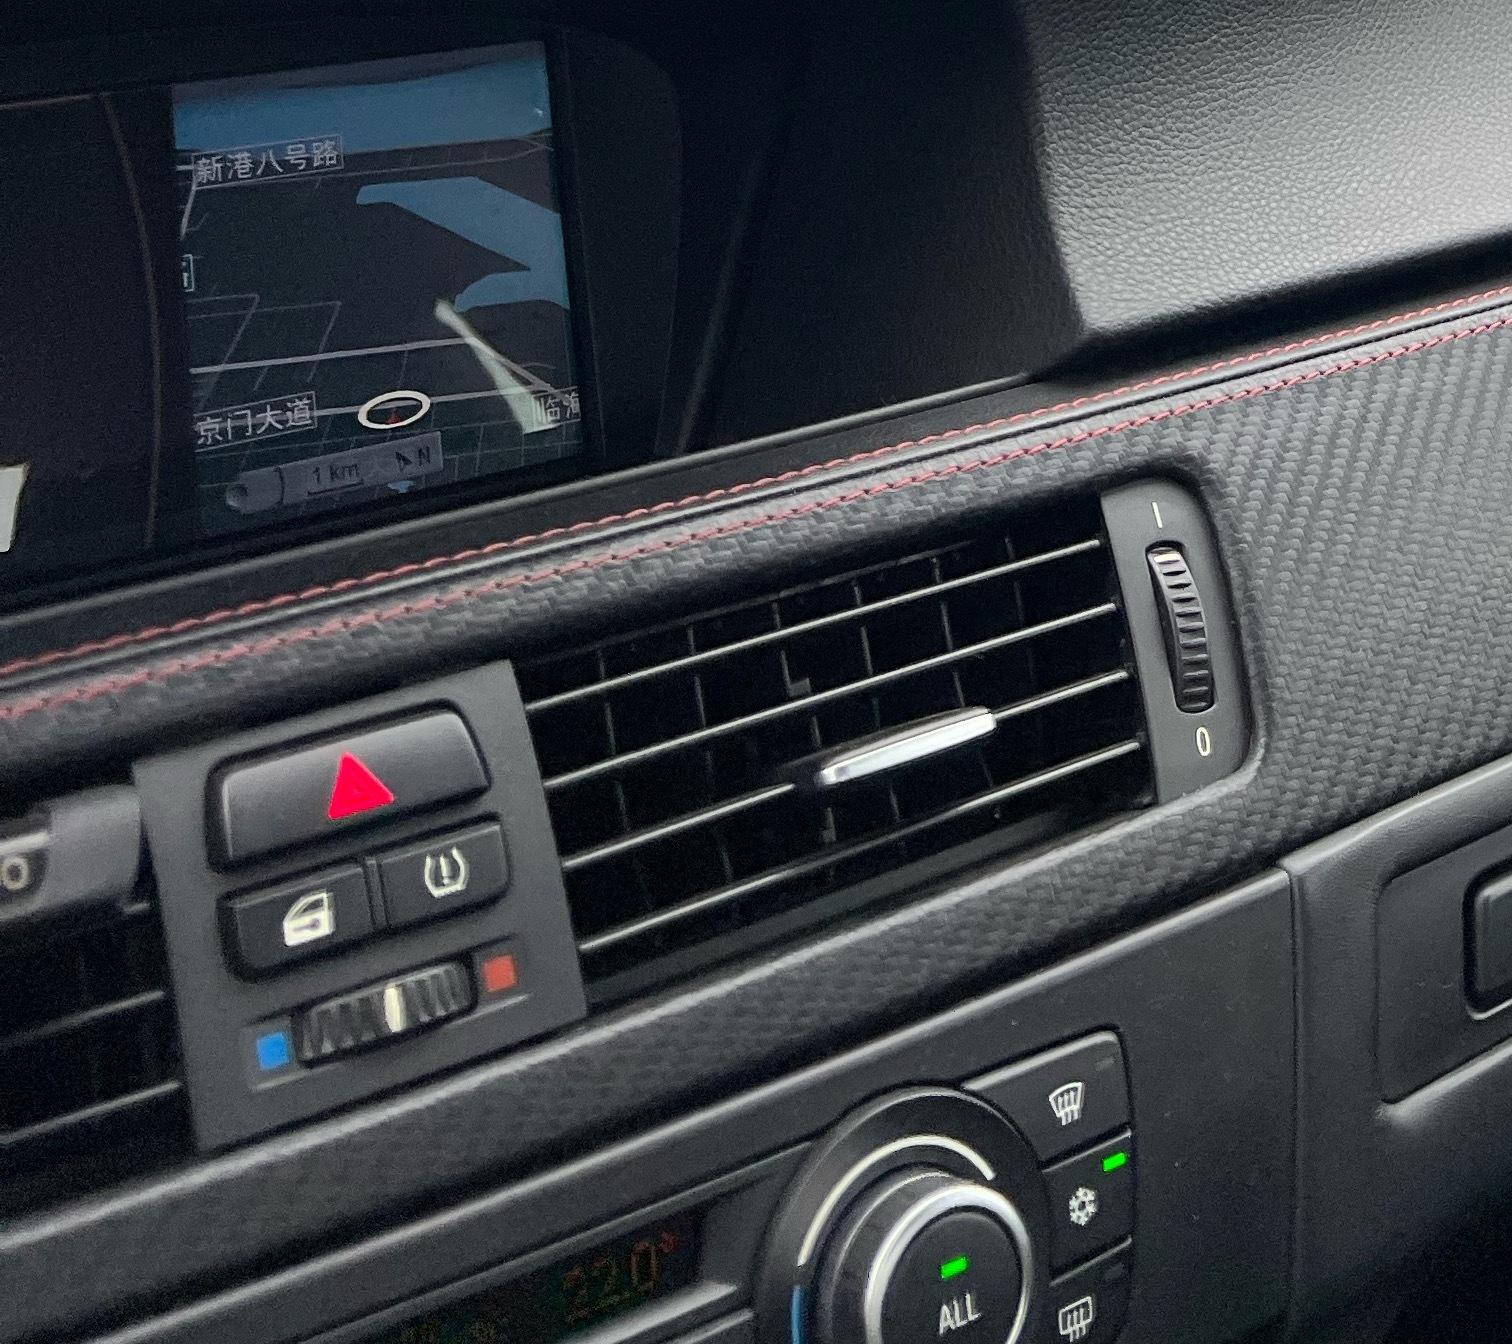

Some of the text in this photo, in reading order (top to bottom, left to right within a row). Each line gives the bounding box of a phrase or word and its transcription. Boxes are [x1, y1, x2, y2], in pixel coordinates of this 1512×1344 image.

[193, 139, 341, 184] 新港八号路
[196, 397, 313, 447] 京门大道
[329, 461, 361, 482] km
[938, 1291, 983, 1336] ALL
